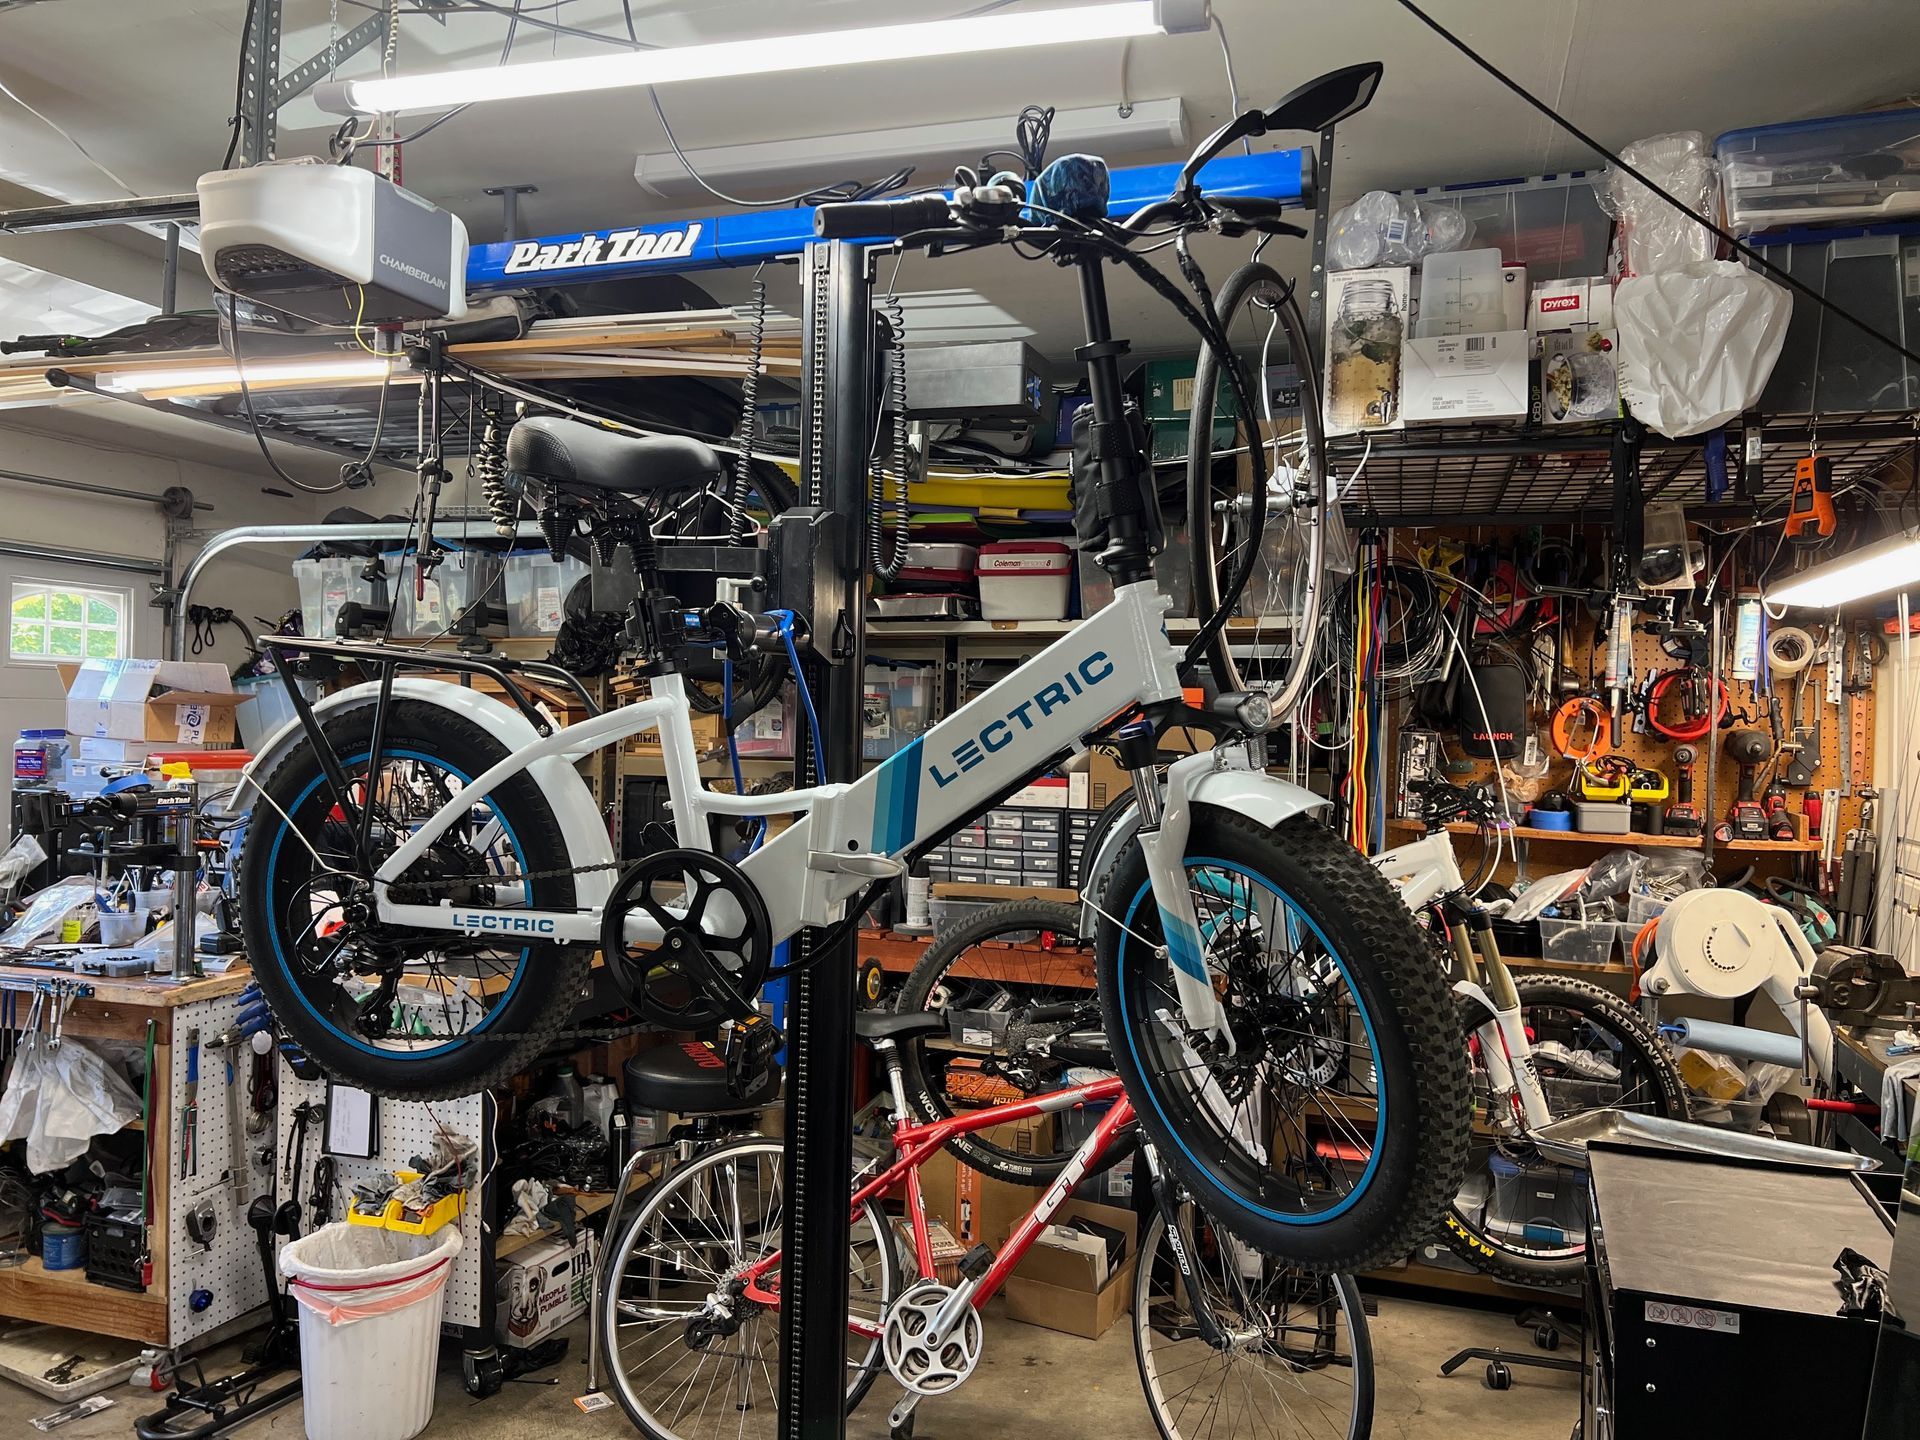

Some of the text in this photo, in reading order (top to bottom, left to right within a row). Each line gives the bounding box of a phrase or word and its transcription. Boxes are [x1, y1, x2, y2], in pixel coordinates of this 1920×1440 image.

[504, 223, 702, 273] Park Tool
[379, 253, 448, 290] CHAMBERLAIN
[1543, 298, 1576, 310] pyrex
[1532, 385, 1542, 423] ICED DIP
[929, 651, 1114, 788] LECTRIC
[1473, 732, 1514, 741] LAUNCH
[453, 913, 555, 933] LECTRIC
[1592, 1003, 1666, 1067] ARDENT
[677, 1041, 726, 1069] PROTO
[1034, 1151, 1086, 1224] GT
